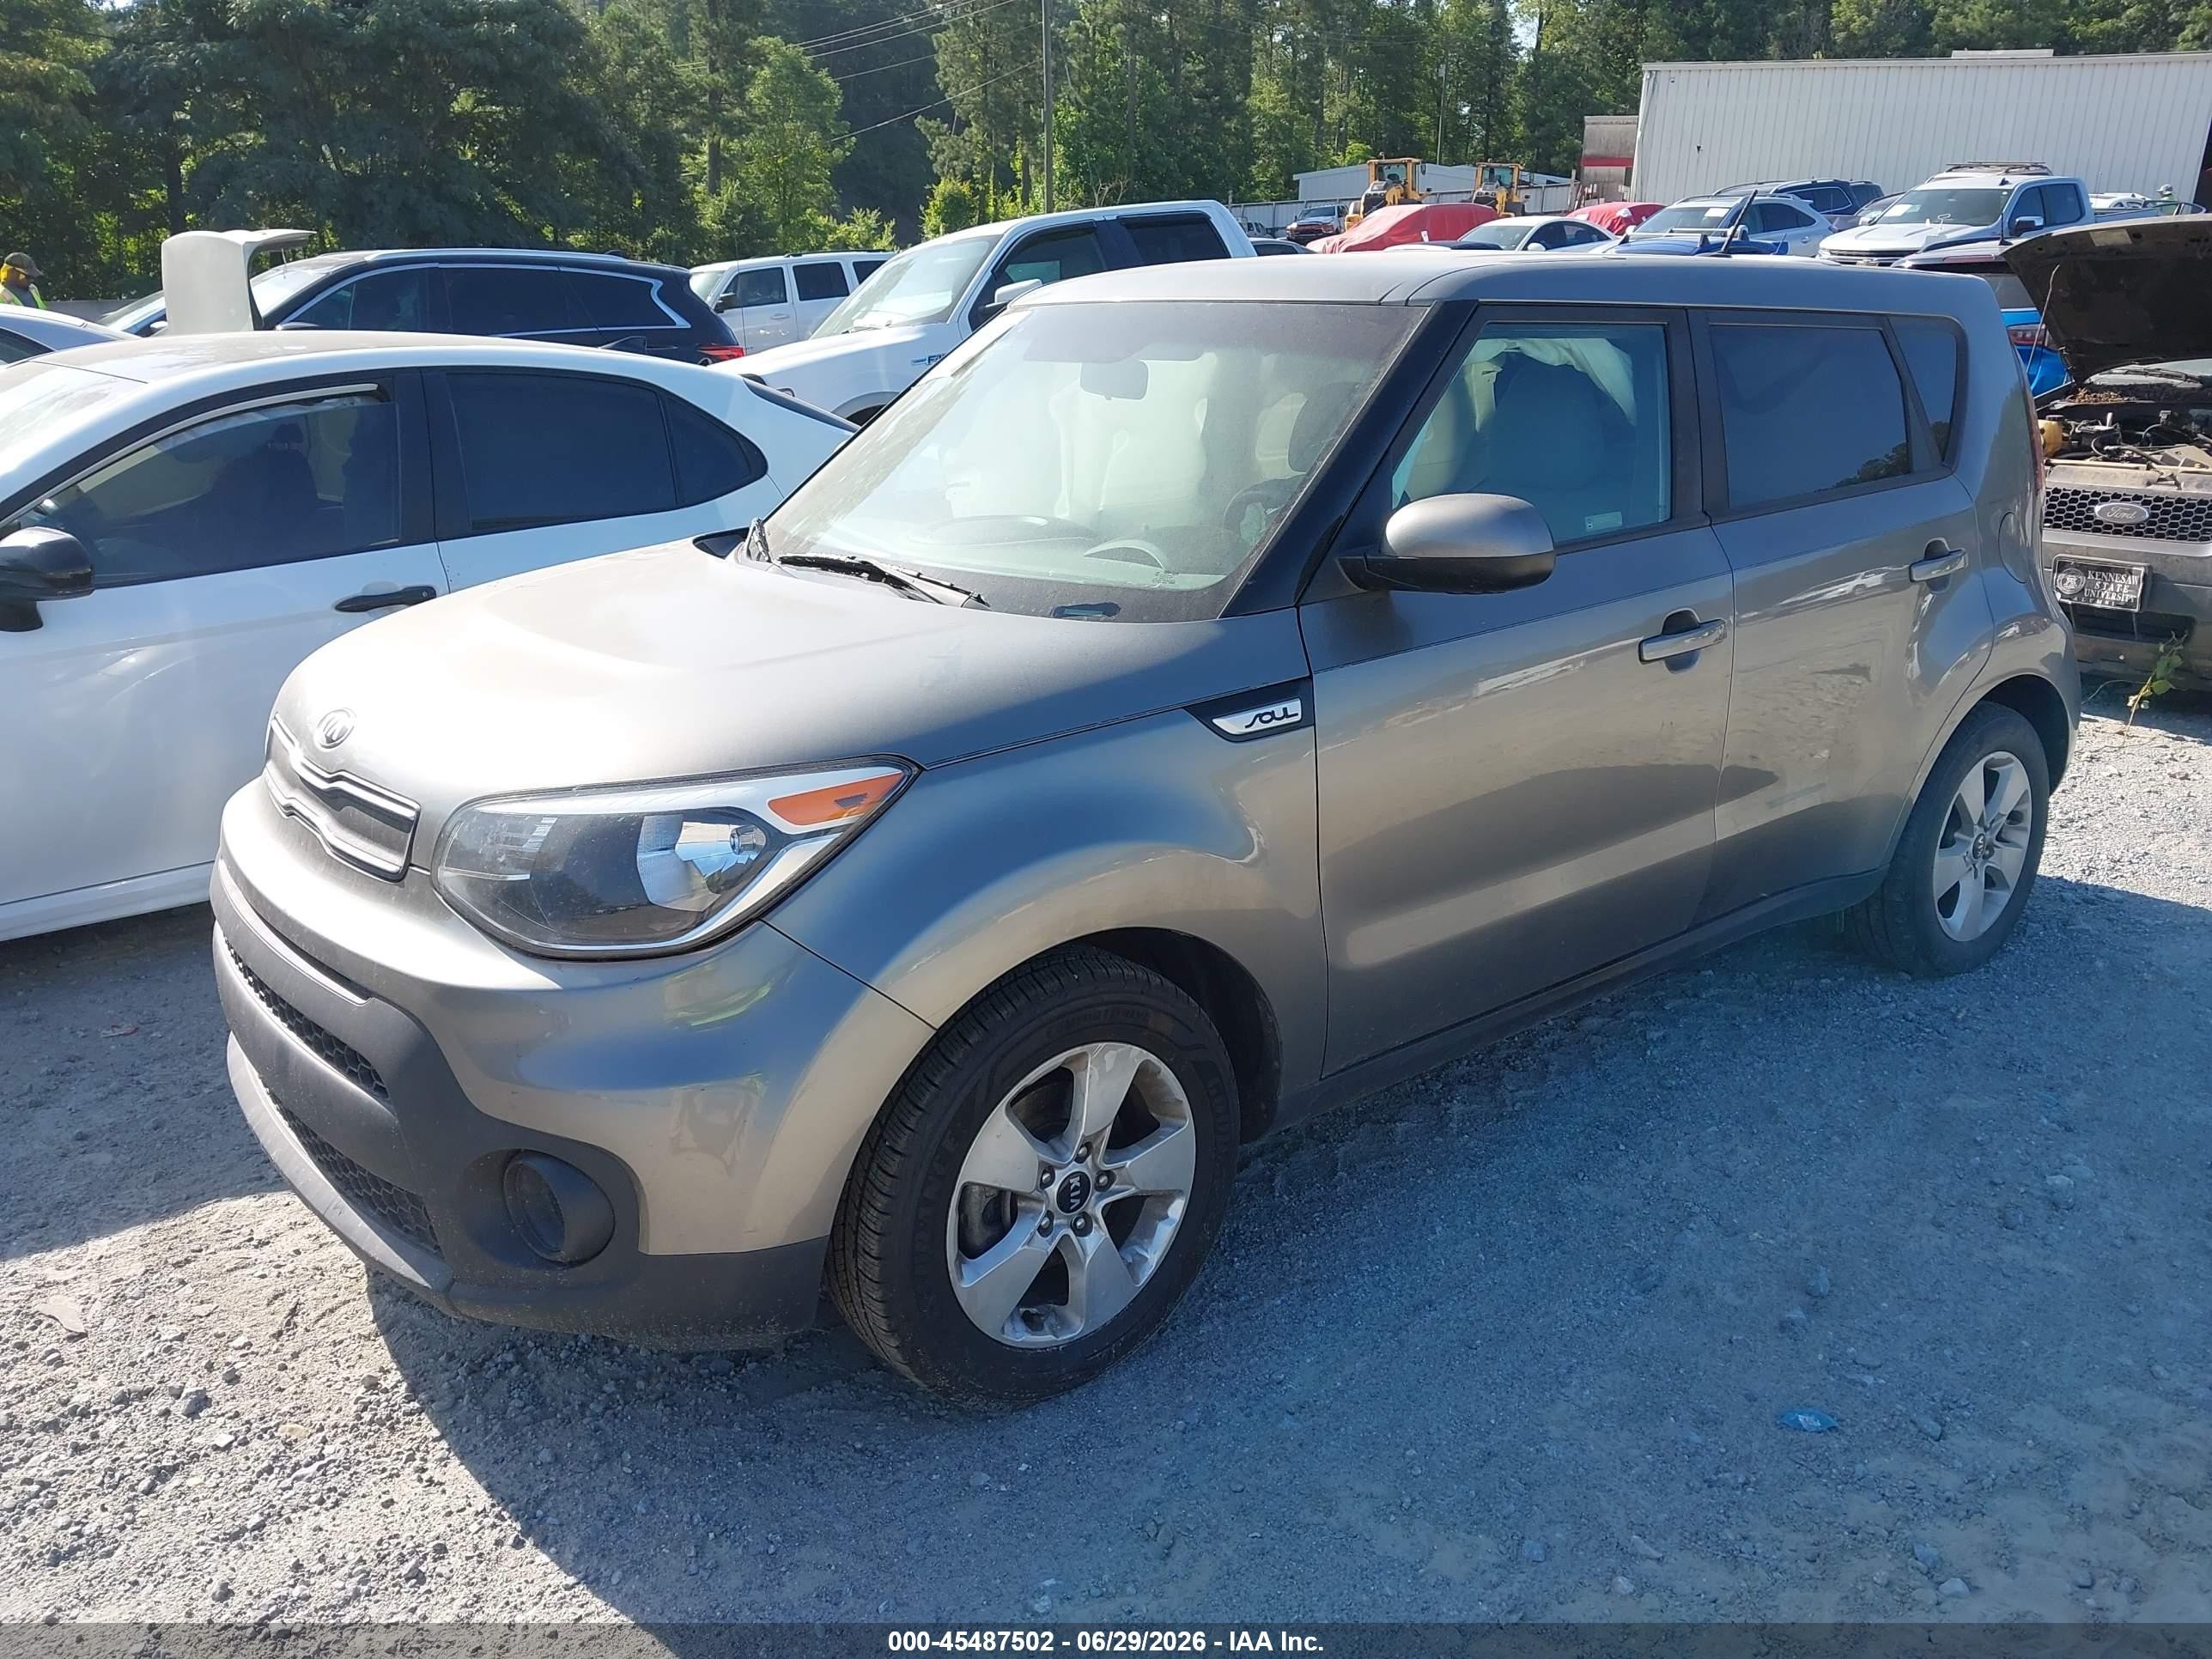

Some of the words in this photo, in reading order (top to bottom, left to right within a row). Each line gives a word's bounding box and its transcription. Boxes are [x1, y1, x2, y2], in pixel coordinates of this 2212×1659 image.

[2107, 507, 2136, 519] Ford
[2087, 570, 2140, 585] KENNESAW
[2095, 581, 2130, 592] STATE
[2073, 597, 2115, 605] ALUMNI
[2084, 588, 2136, 603] UNIVERSITY
[1244, 707, 1299, 729] SOUL
[1069, 1176, 1081, 1211] KIA
